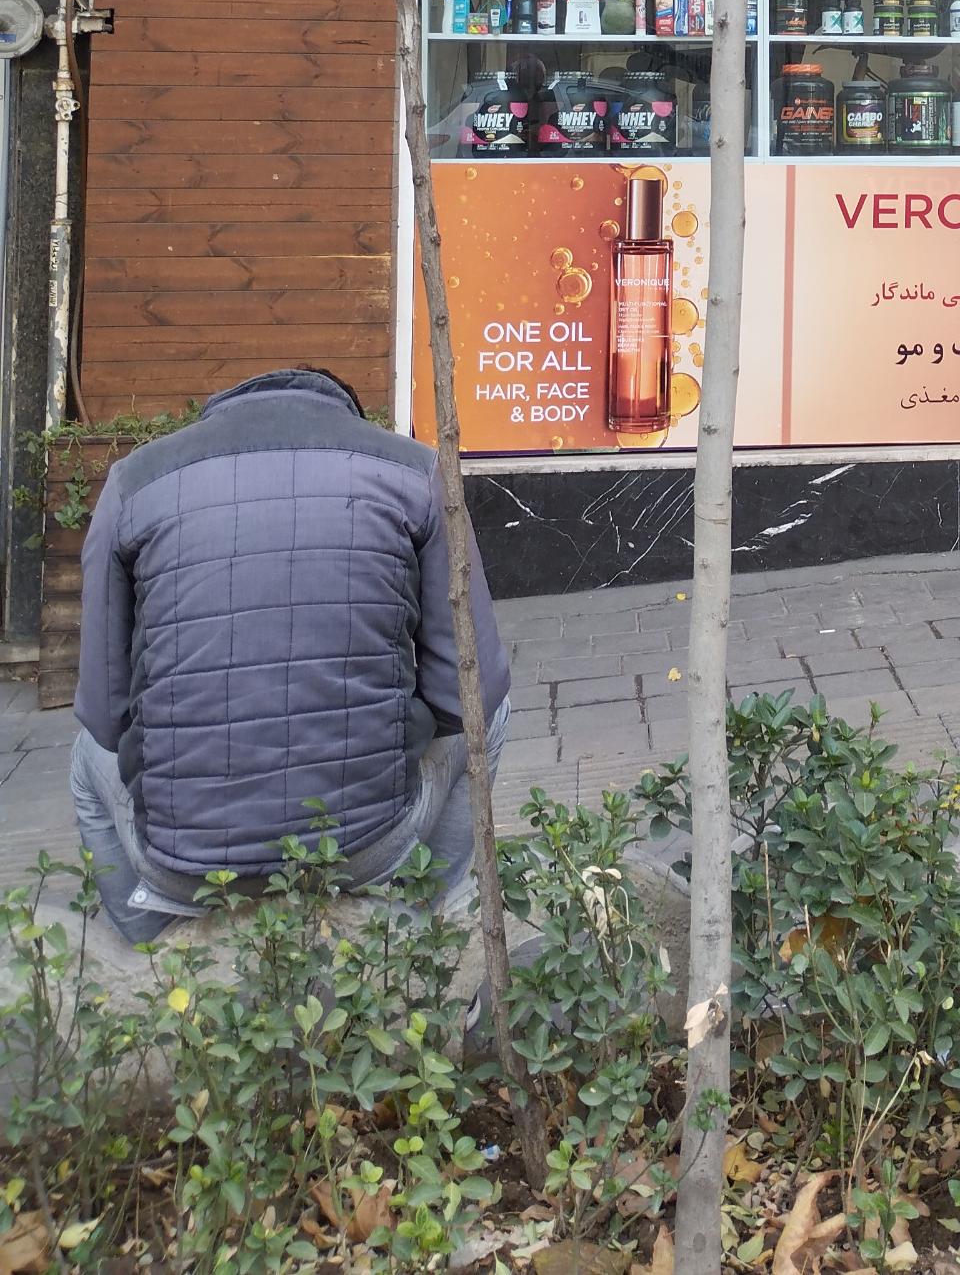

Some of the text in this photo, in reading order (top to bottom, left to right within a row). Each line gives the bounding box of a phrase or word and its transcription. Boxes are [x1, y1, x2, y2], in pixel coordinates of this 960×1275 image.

[478, 113, 514, 128] WHEY
[561, 111, 597, 126] WHEY
[620, 111, 656, 126] WHEY
[870, 281, 935, 307] ماندگار
[483, 322, 542, 343] ONE
[549, 321, 593, 343] OIL
[478, 350, 592, 372] FOR ALL
[895, 342, 924, 365] مو
[932, 343, 944, 365] و
[475, 382, 590, 402] HAIR, FACE
[900, 385, 960, 410] مغذی
[510, 405, 590, 422] & BODY
